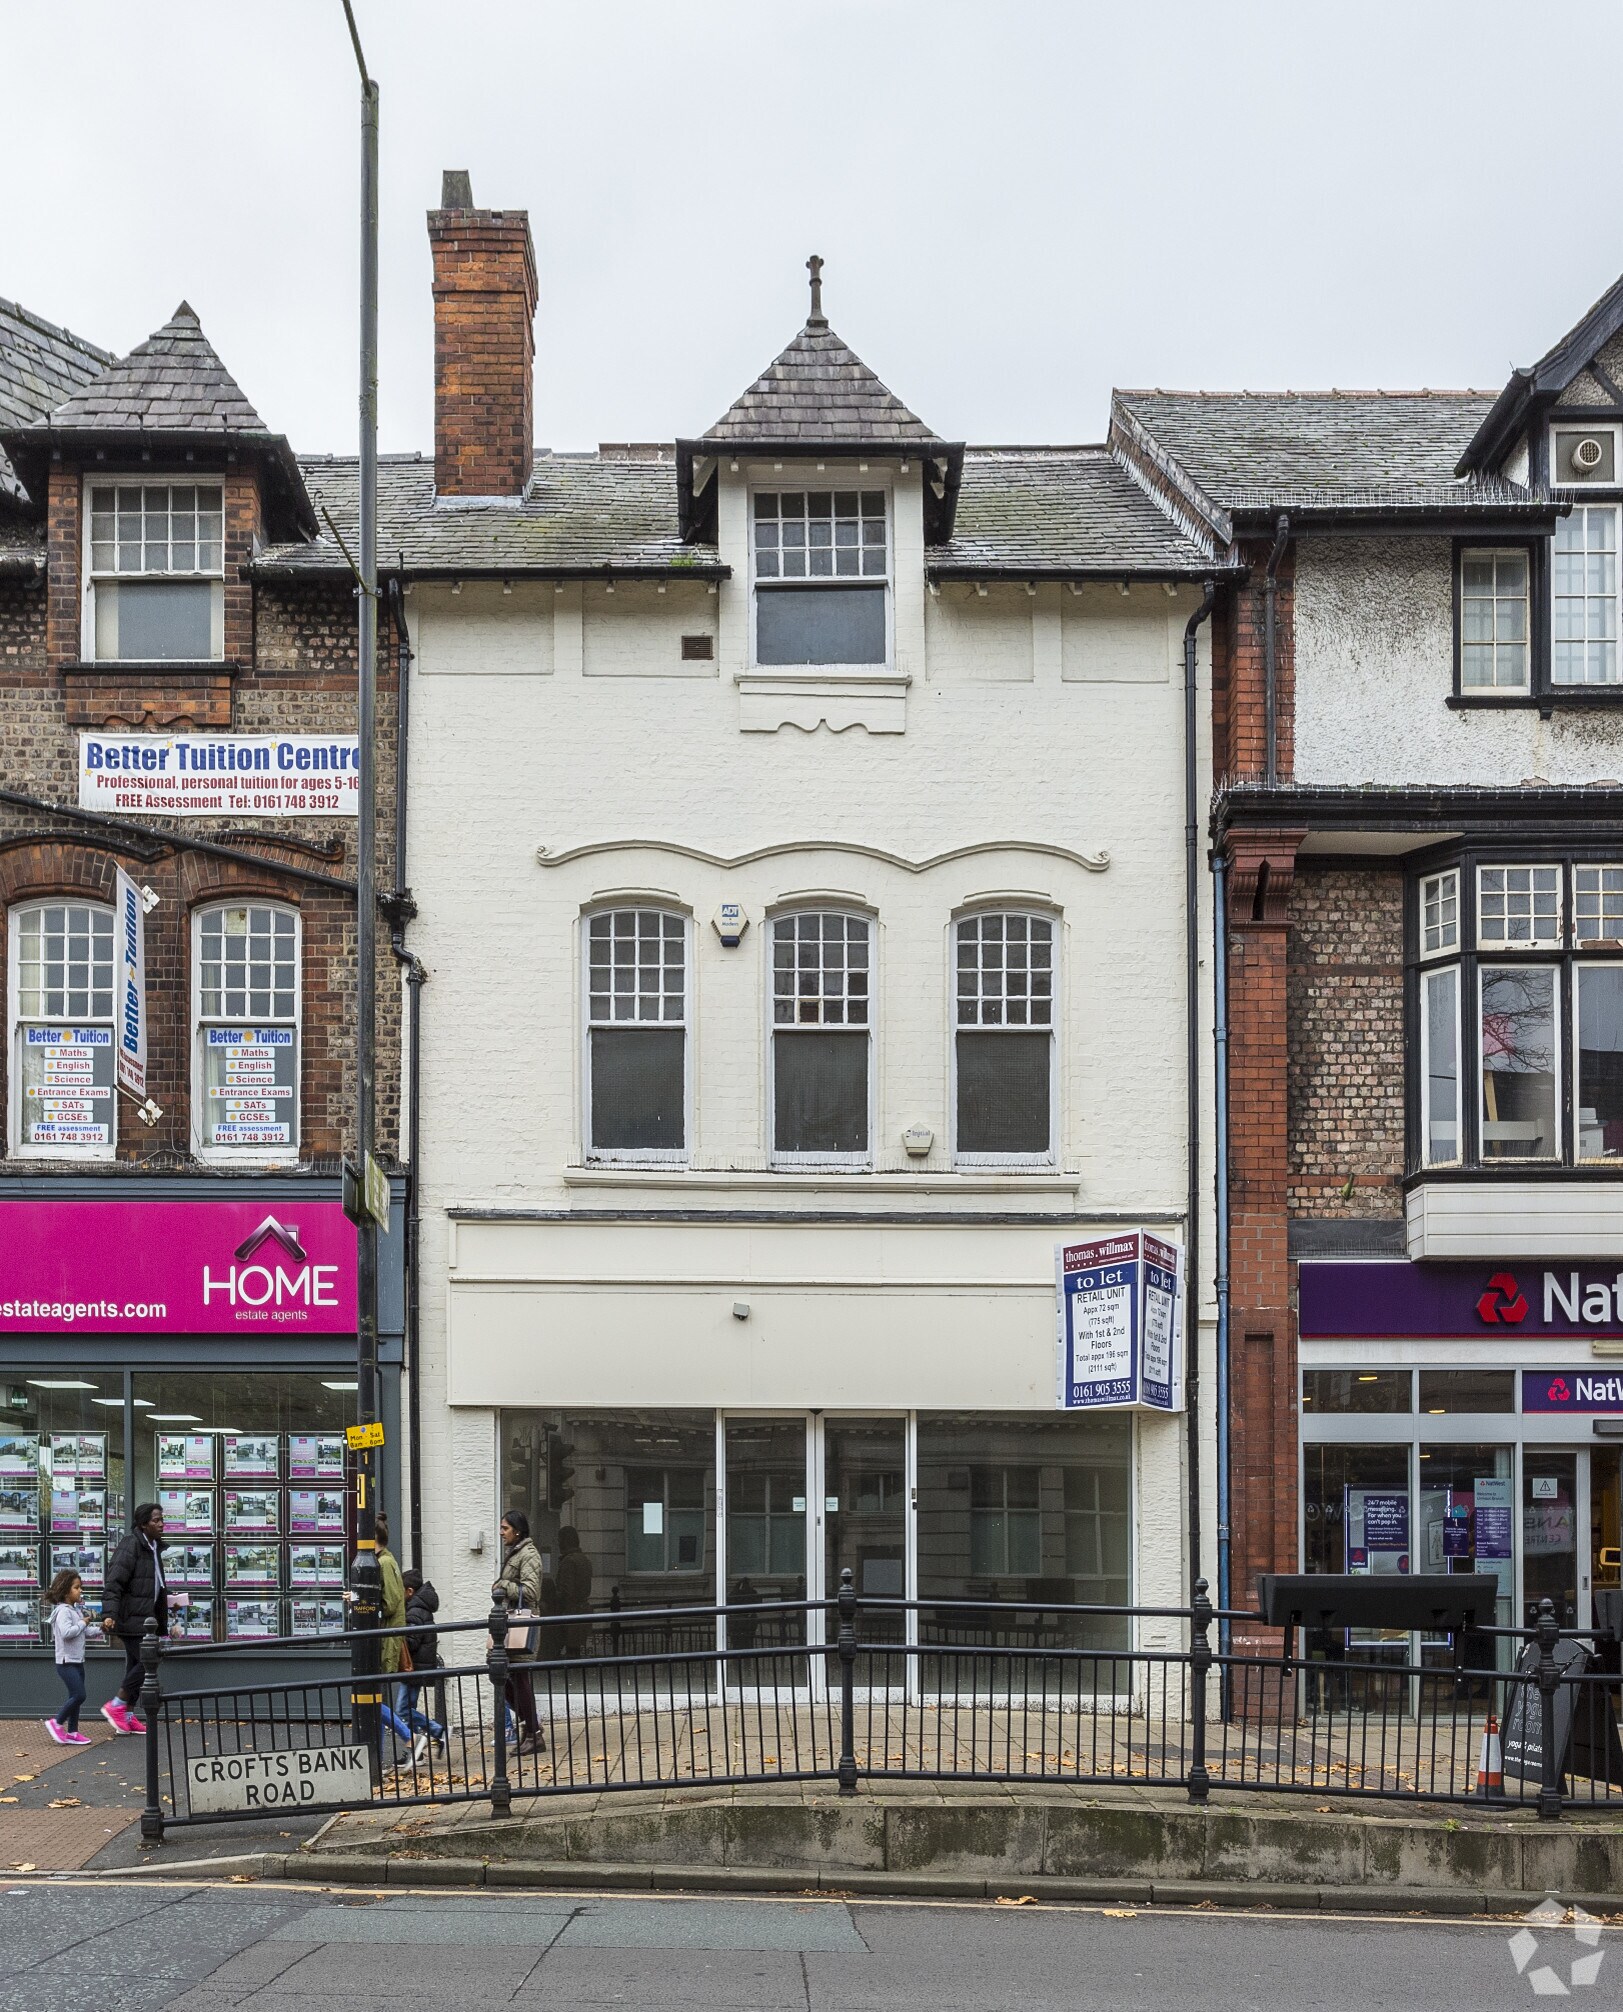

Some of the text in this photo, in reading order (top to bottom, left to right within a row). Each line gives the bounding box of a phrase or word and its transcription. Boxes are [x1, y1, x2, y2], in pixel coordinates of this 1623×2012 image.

[87, 743, 170, 770] Better
[176, 743, 269, 770] Tuition
[97, 775, 178, 790] Professional,
[182, 776, 238, 791] personal
[240, 776, 278, 790] tuition
[281, 776, 298, 790] for
[301, 778, 332, 791] ages
[115, 794, 338, 808] FREE Assessment Tel: 0161 748 3912
[722, 906, 738, 916] ADT
[123, 887, 139, 1054] Better Tuition
[29, 1030, 109, 1044] Better Tuition
[210, 1030, 290, 1044] Better Tuition
[57, 1062, 90, 1071] English
[238, 1062, 271, 1071] English
[54, 1075, 91, 1083] Science
[236, 1075, 272, 1083] Science
[37, 1088, 108, 1096] Entrance Exams
[219, 1088, 290, 1096] Entrance Exams
[34, 1133, 103, 1141] 0161 748 3912
[216, 1133, 284, 1141] 0161 748 3912
[204, 1266, 338, 1306] HOME
[1076, 1270, 1123, 1289] to let
[1151, 1270, 1171, 1289] to let
[1077, 1287, 1125, 1303] RETAIL UNIT
[0, 1299, 167, 1322] stateagents.com
[1107, 1303, 1119, 1311] sqm
[235, 1310, 308, 1322] estate agents
[1089, 1316, 1114, 1327] (775 sqft)
[1078, 1326, 1125, 1340] With 1st & 2nd
[1091, 1340, 1112, 1349] Floors
[1088, 1364, 1102, 1374] (2111
[1073, 1381, 1131, 1398] 0161 905 3555
[194, 1748, 363, 1783] CROFTS BANK
[246, 1780, 315, 1806] ROAD
